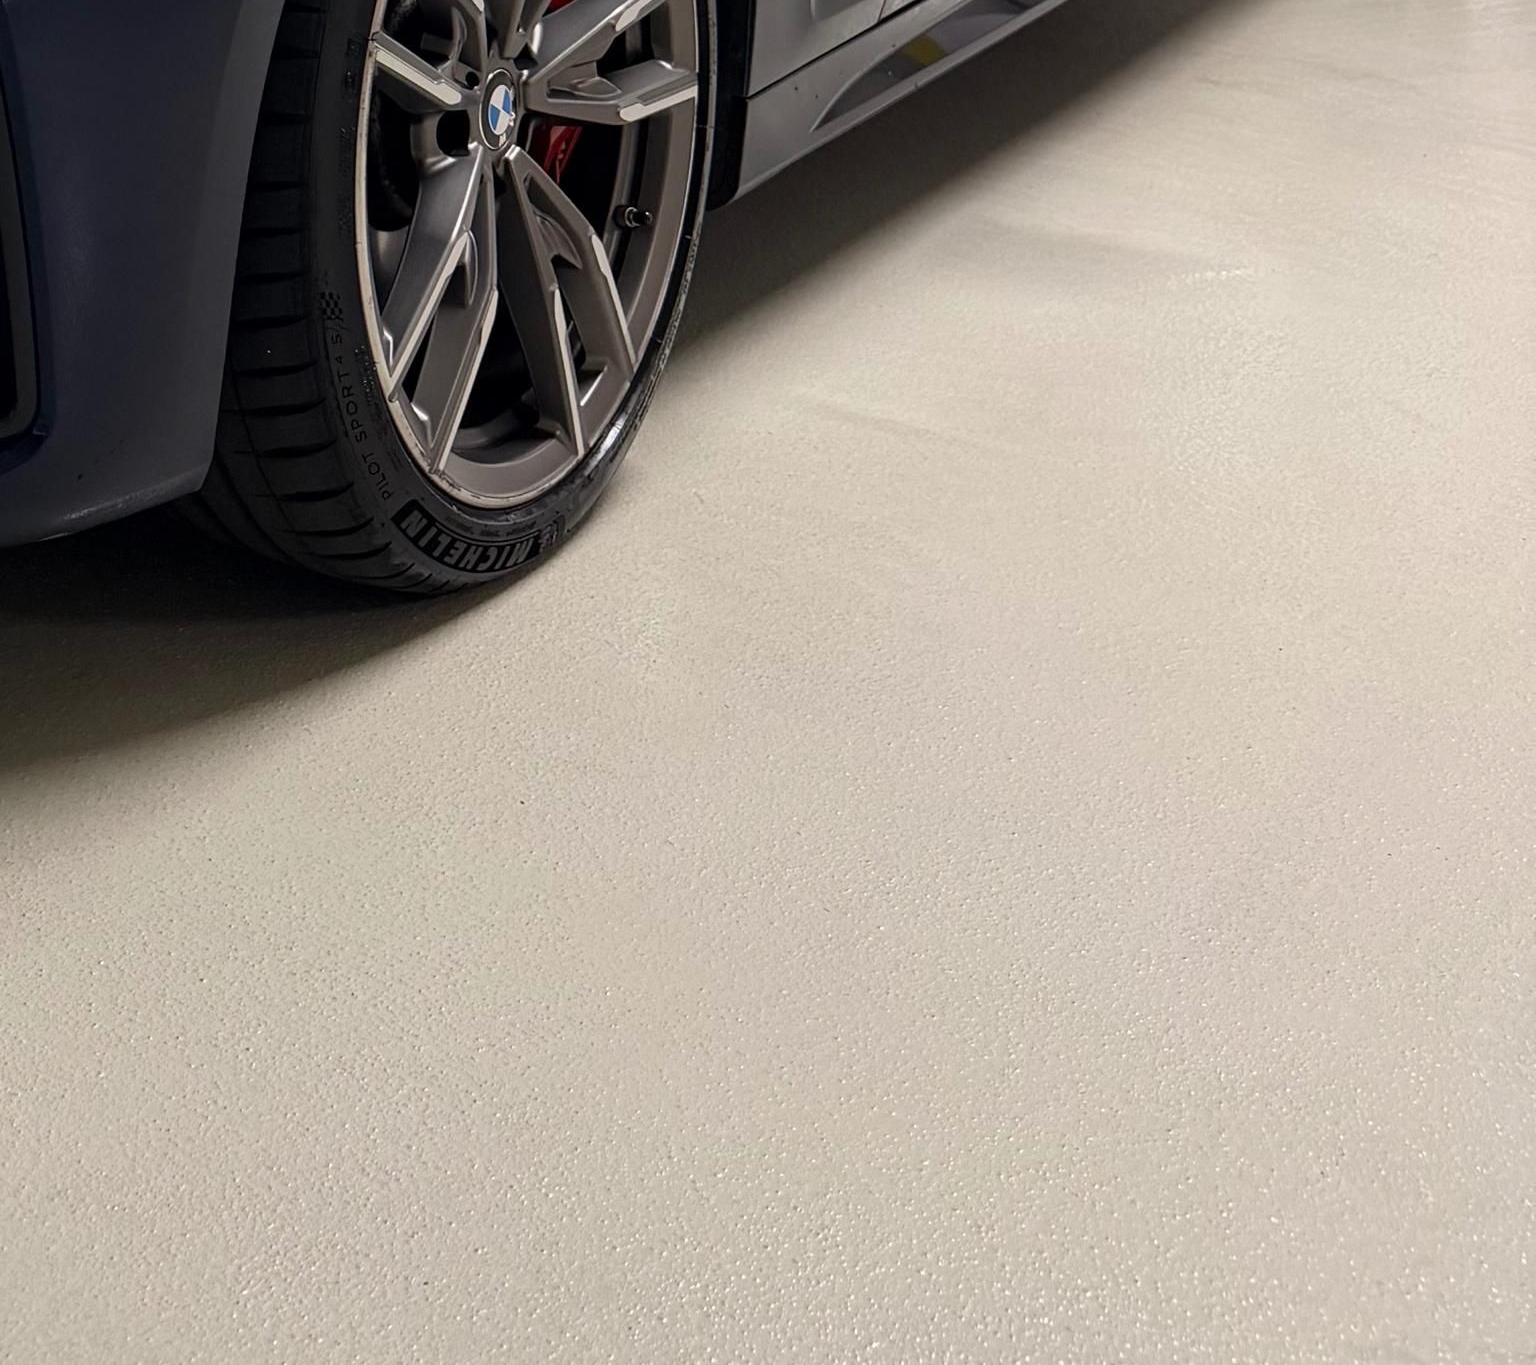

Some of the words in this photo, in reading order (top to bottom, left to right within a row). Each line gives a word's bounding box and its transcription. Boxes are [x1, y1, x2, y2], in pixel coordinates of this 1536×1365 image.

[331, 333, 343, 345] S
[335, 355, 343, 365] 4
[337, 371, 367, 443] SPORT
[362, 452, 393, 501] PILOT
[399, 509, 534, 571] MICHELIN
